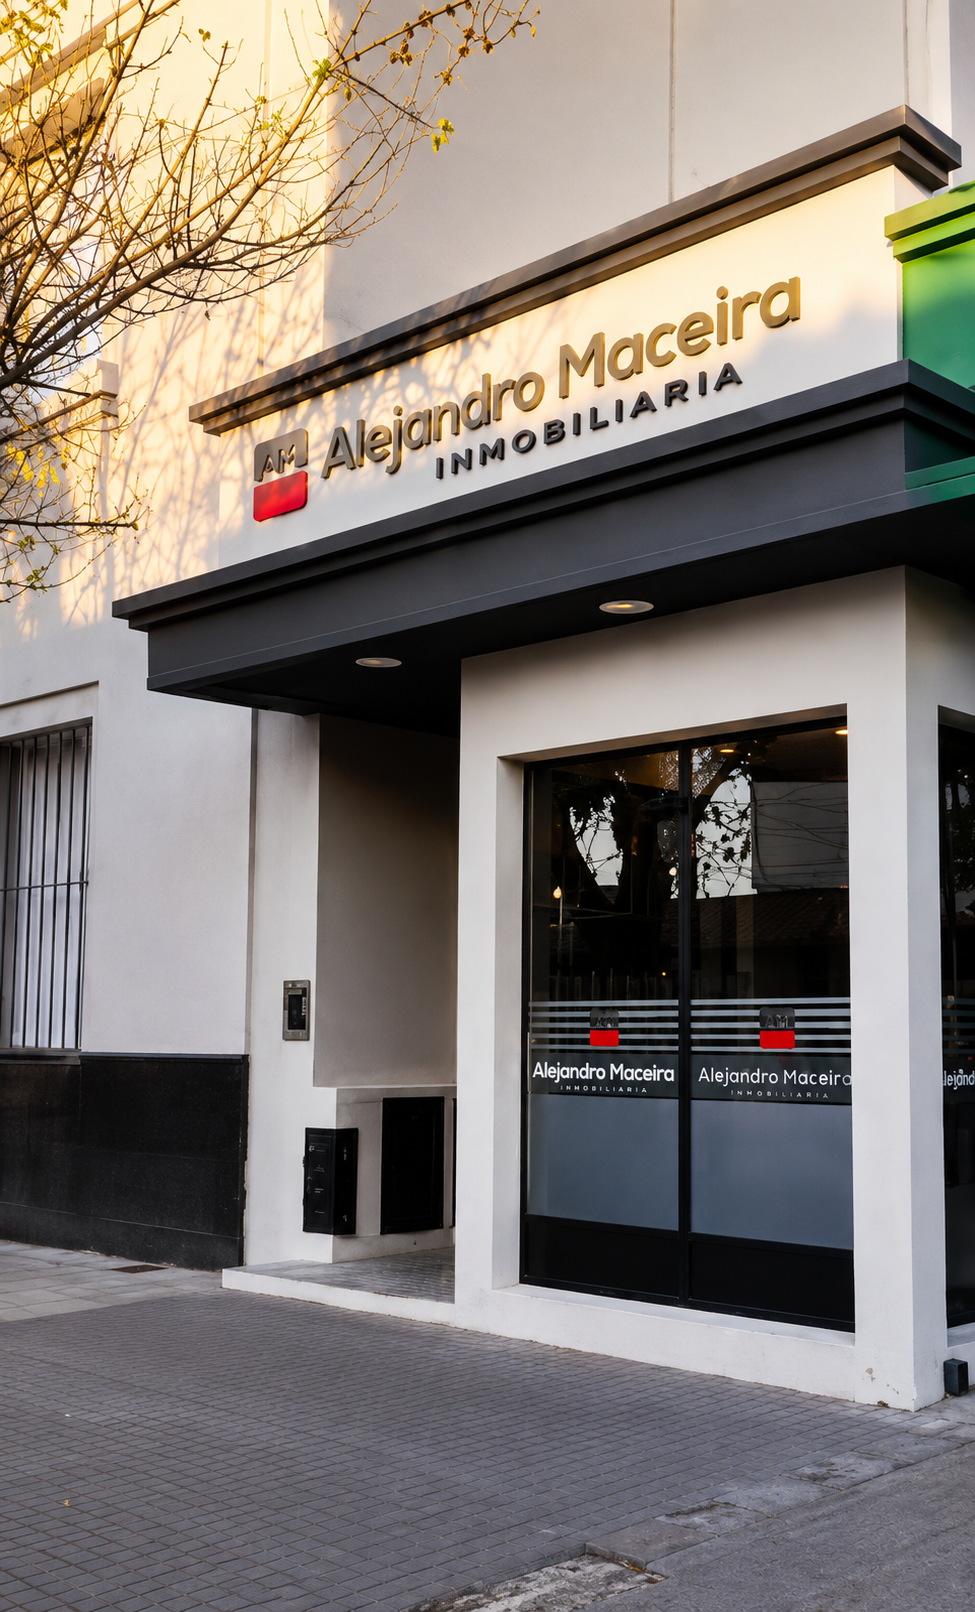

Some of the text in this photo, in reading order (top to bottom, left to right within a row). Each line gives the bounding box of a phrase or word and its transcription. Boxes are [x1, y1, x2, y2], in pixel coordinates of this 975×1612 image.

[321, 276, 801, 479] Alejandro Maceira
[436, 362, 743, 479] INMOBILIARIA
[257, 442, 298, 481] AM
[532, 1061, 675, 1083] Alejandro Maceira
[698, 1067, 852, 1087] Alejandro Maceira
[943, 1070, 975, 1090] lejand
[560, 1085, 647, 1093] INMOBILIARIA
[731, 1089, 829, 1098] INMOBILIARIA
